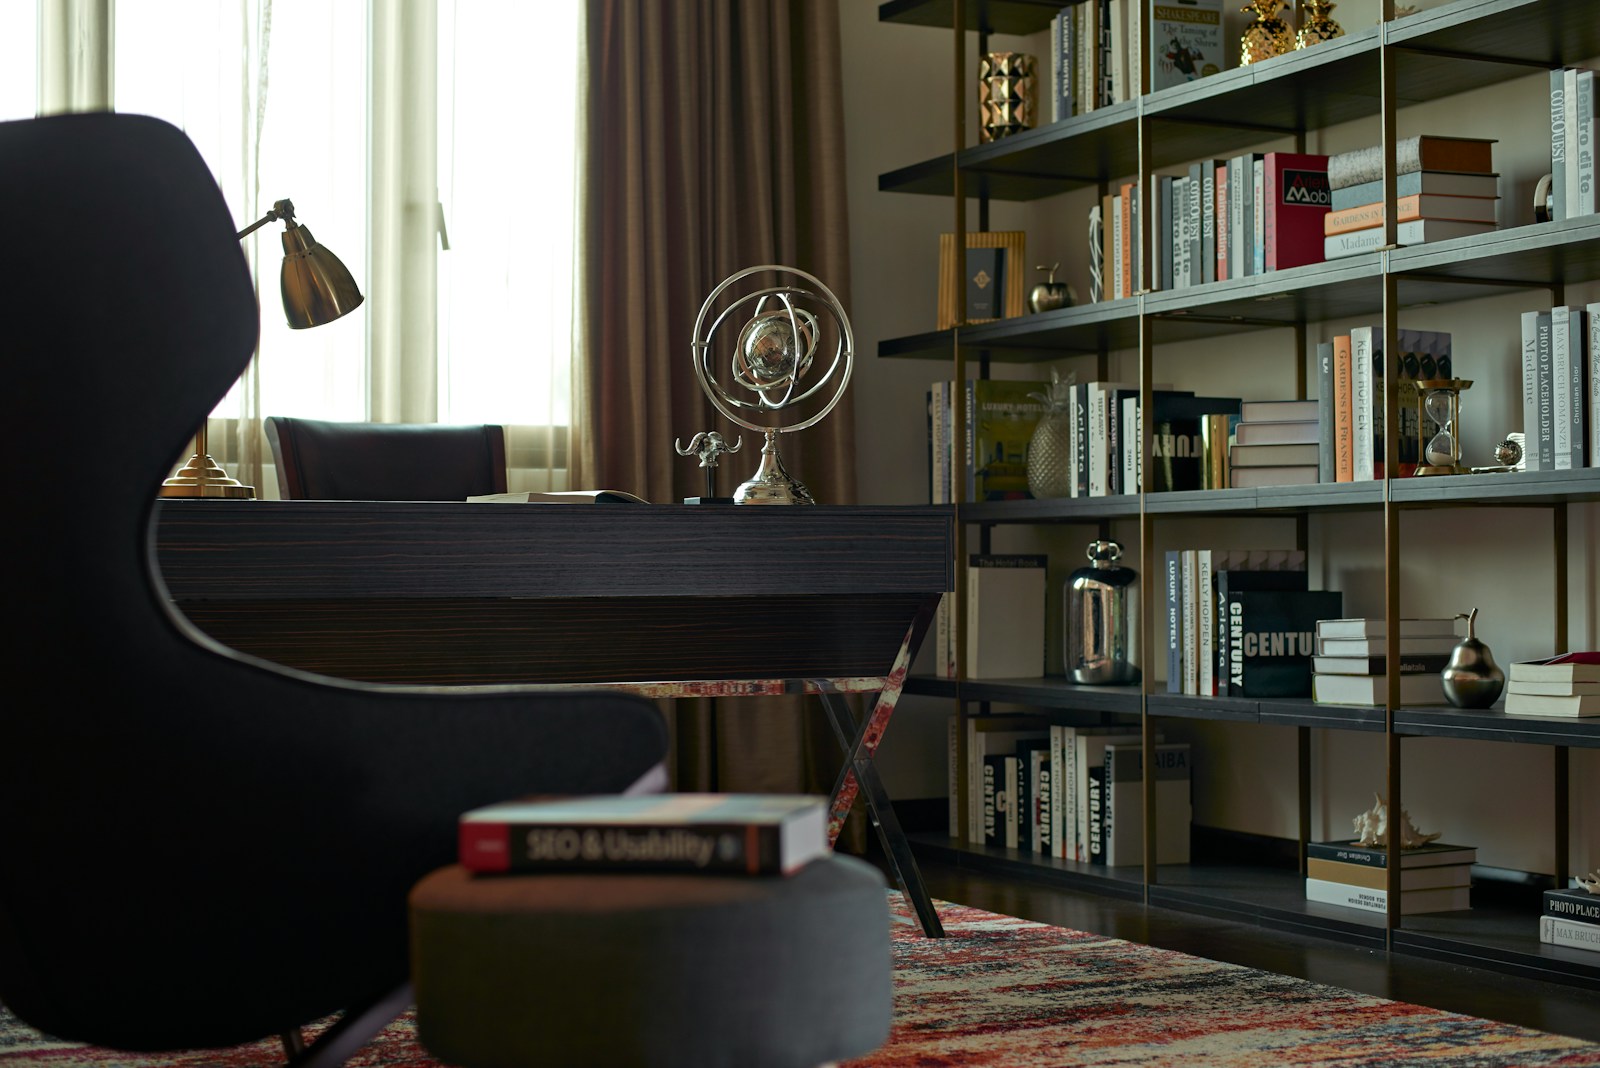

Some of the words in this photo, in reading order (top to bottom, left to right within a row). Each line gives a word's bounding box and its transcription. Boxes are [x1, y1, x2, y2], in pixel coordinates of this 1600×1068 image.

[1156, 8, 1217, 22] SHAKESPEARE
[1578, 78, 1591, 146] Dentro
[1580, 150, 1591, 168] di
[1580, 174, 1591, 194] te
[1173, 186, 1181, 239] Dentro
[1182, 182, 1190, 235] Dentro
[1216, 182, 1227, 260] Trainspotting
[1333, 212, 1370, 226] GARDENS
[1174, 243, 1182, 257] di
[1183, 239, 1190, 254] di
[1340, 235, 1380, 251] Madame
[1174, 261, 1182, 277] te
[1183, 257, 1190, 273] te
[1540, 325, 1549, 362] PHOTO
[1557, 328, 1565, 351] MAX
[1357, 340, 1366, 376] KELLY
[1525, 340, 1536, 405] Madame
[1557, 354, 1565, 390] BRUCH
[1339, 349, 1347, 407] GARDENS
[1340, 411, 1347, 423] IN
[1358, 380, 1367, 430] HOPPEN
[1540, 364, 1550, 442] PLACEHOLDER
[1558, 393, 1566, 449] ROMANZE
[1340, 427, 1348, 474] FRANCE
[980, 558, 994, 567] The
[995, 558, 1017, 567] Hotel
[1018, 558, 1038, 568] Book
[1230, 601, 1243, 687] CENTURY
[984, 764, 995, 838] CENTURY
[1040, 770, 1050, 846] CENTURY
[1089, 776, 1101, 855] CENTURY
[525, 829, 582, 861] SEO
[582, 829, 601, 861] &
[603, 829, 715, 868] Usability
[1336, 851, 1348, 859] Dior
[1349, 853, 1371, 862] Christian
[1363, 901, 1386, 910] FURNITURE
[1549, 900, 1575, 915] PHOTO
[1575, 904, 1600, 919] PLACE
[1556, 927, 1573, 940] MAX
[1574, 930, 1600, 944] BRUCH
